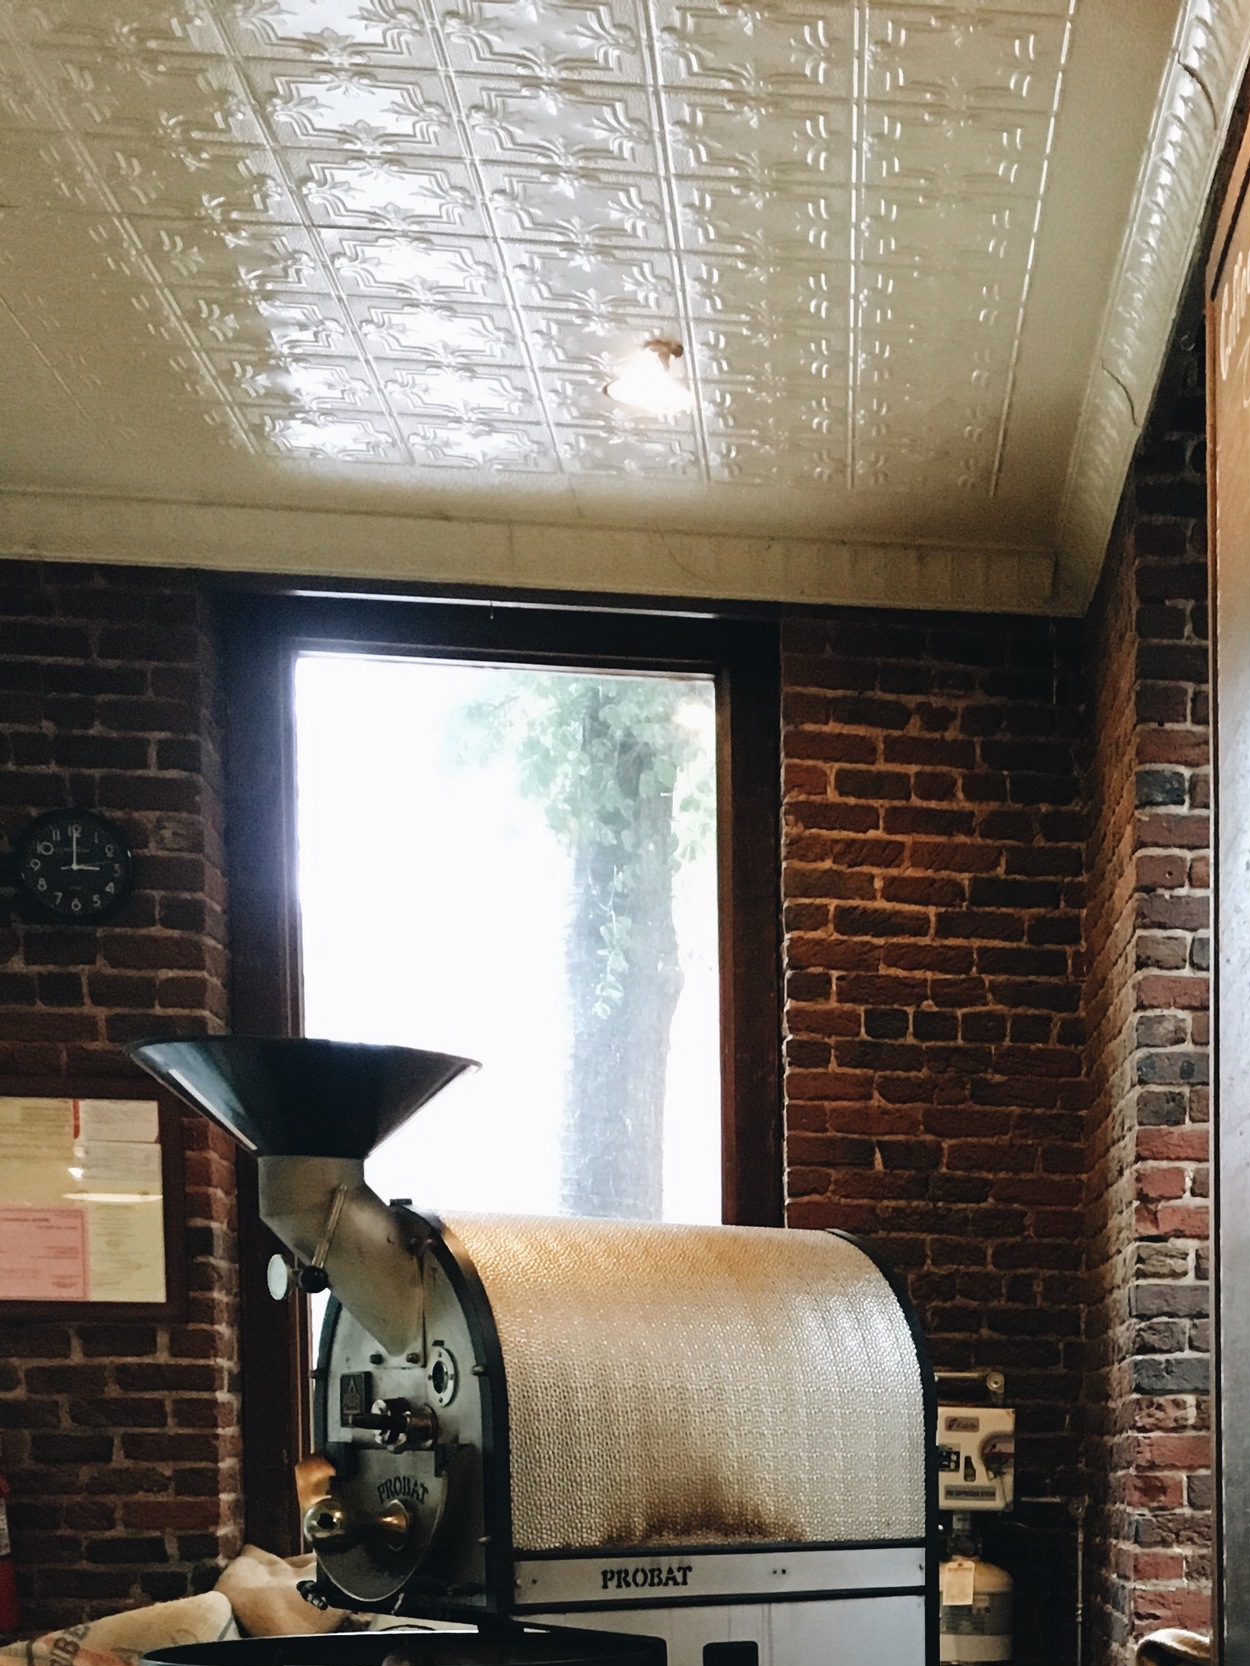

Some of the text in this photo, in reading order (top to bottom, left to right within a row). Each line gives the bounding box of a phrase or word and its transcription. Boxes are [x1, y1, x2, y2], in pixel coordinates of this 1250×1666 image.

[37, 877, 47, 892] 8
[105, 882, 115, 894] 4
[54, 892, 63, 905] 7
[71, 898, 82, 911] 6
[601, 1565, 692, 1589] PROBAT
